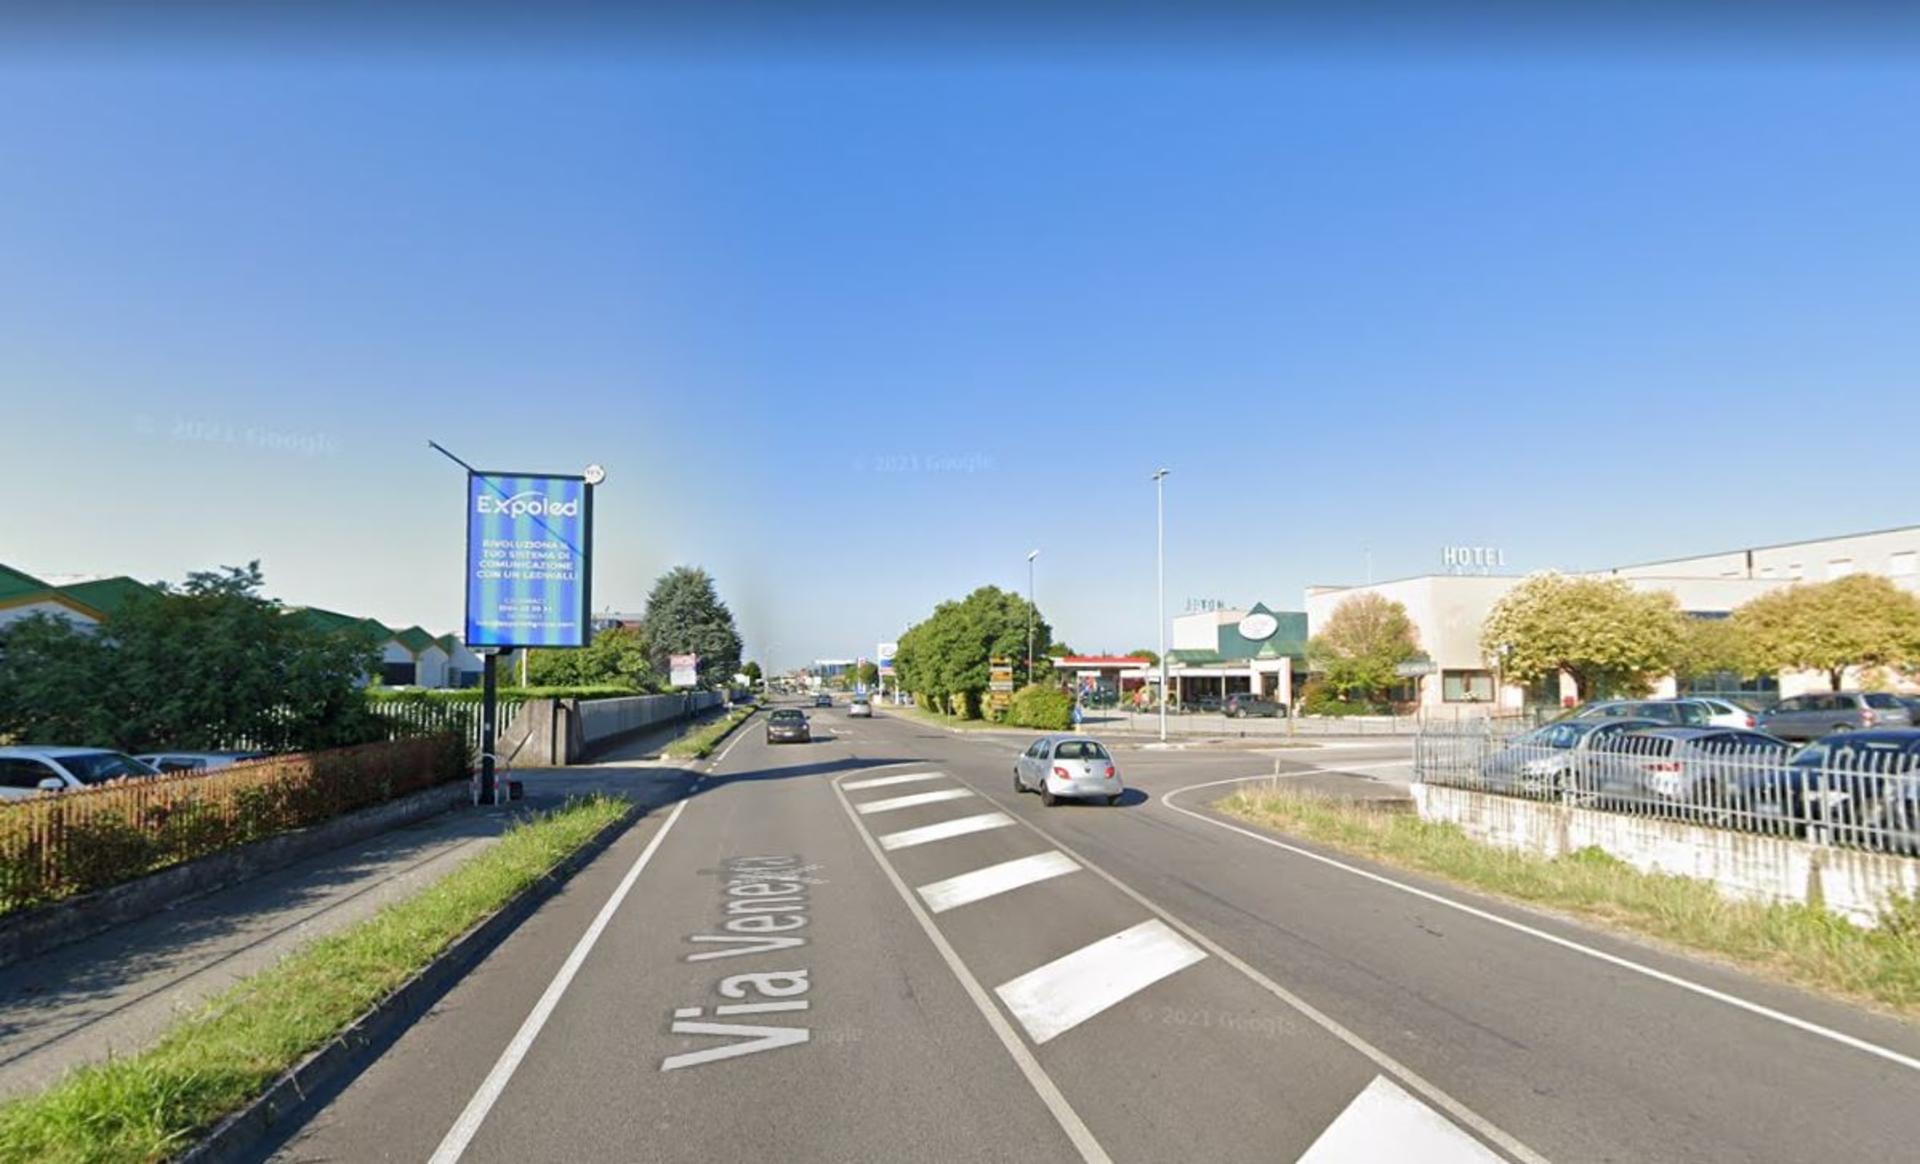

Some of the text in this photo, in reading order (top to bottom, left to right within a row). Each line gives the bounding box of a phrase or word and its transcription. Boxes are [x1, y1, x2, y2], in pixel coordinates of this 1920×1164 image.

[476, 492, 578, 519] Expoled
[479, 560, 574, 570] COMUNICAZIONE
[1441, 545, 1505, 566] HOTEL
